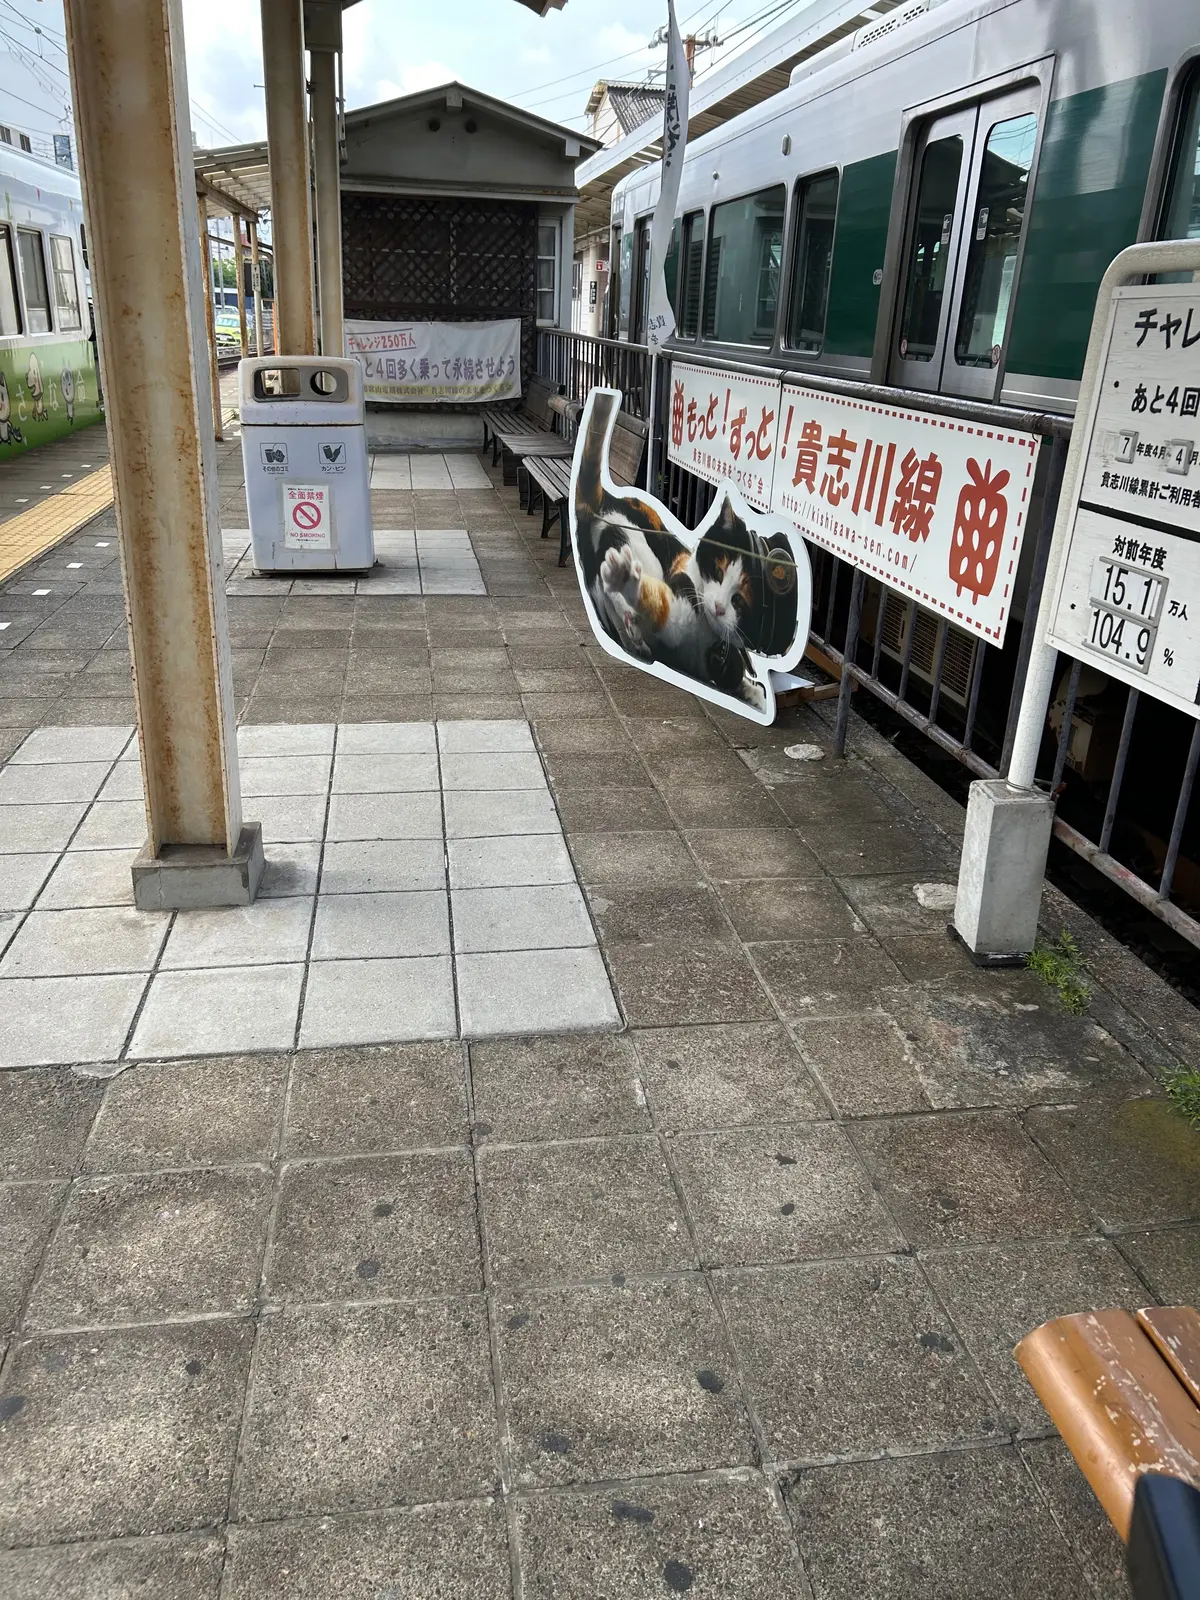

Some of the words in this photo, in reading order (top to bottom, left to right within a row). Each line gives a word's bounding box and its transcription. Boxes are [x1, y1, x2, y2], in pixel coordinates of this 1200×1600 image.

[348, 333, 416, 351] チャレンジ250万人
[356, 355, 515, 381] と4回多く乗って永続させよう
[1131, 383, 1200, 418] あと4回
[288, 491, 324, 500] 全面禁煙
[1112, 534, 1167, 571] 対前年度
[1168, 599, 1188, 621] 万人
[1092, 609, 1150, 665] 104.9
[1163, 647, 1174, 666] %
